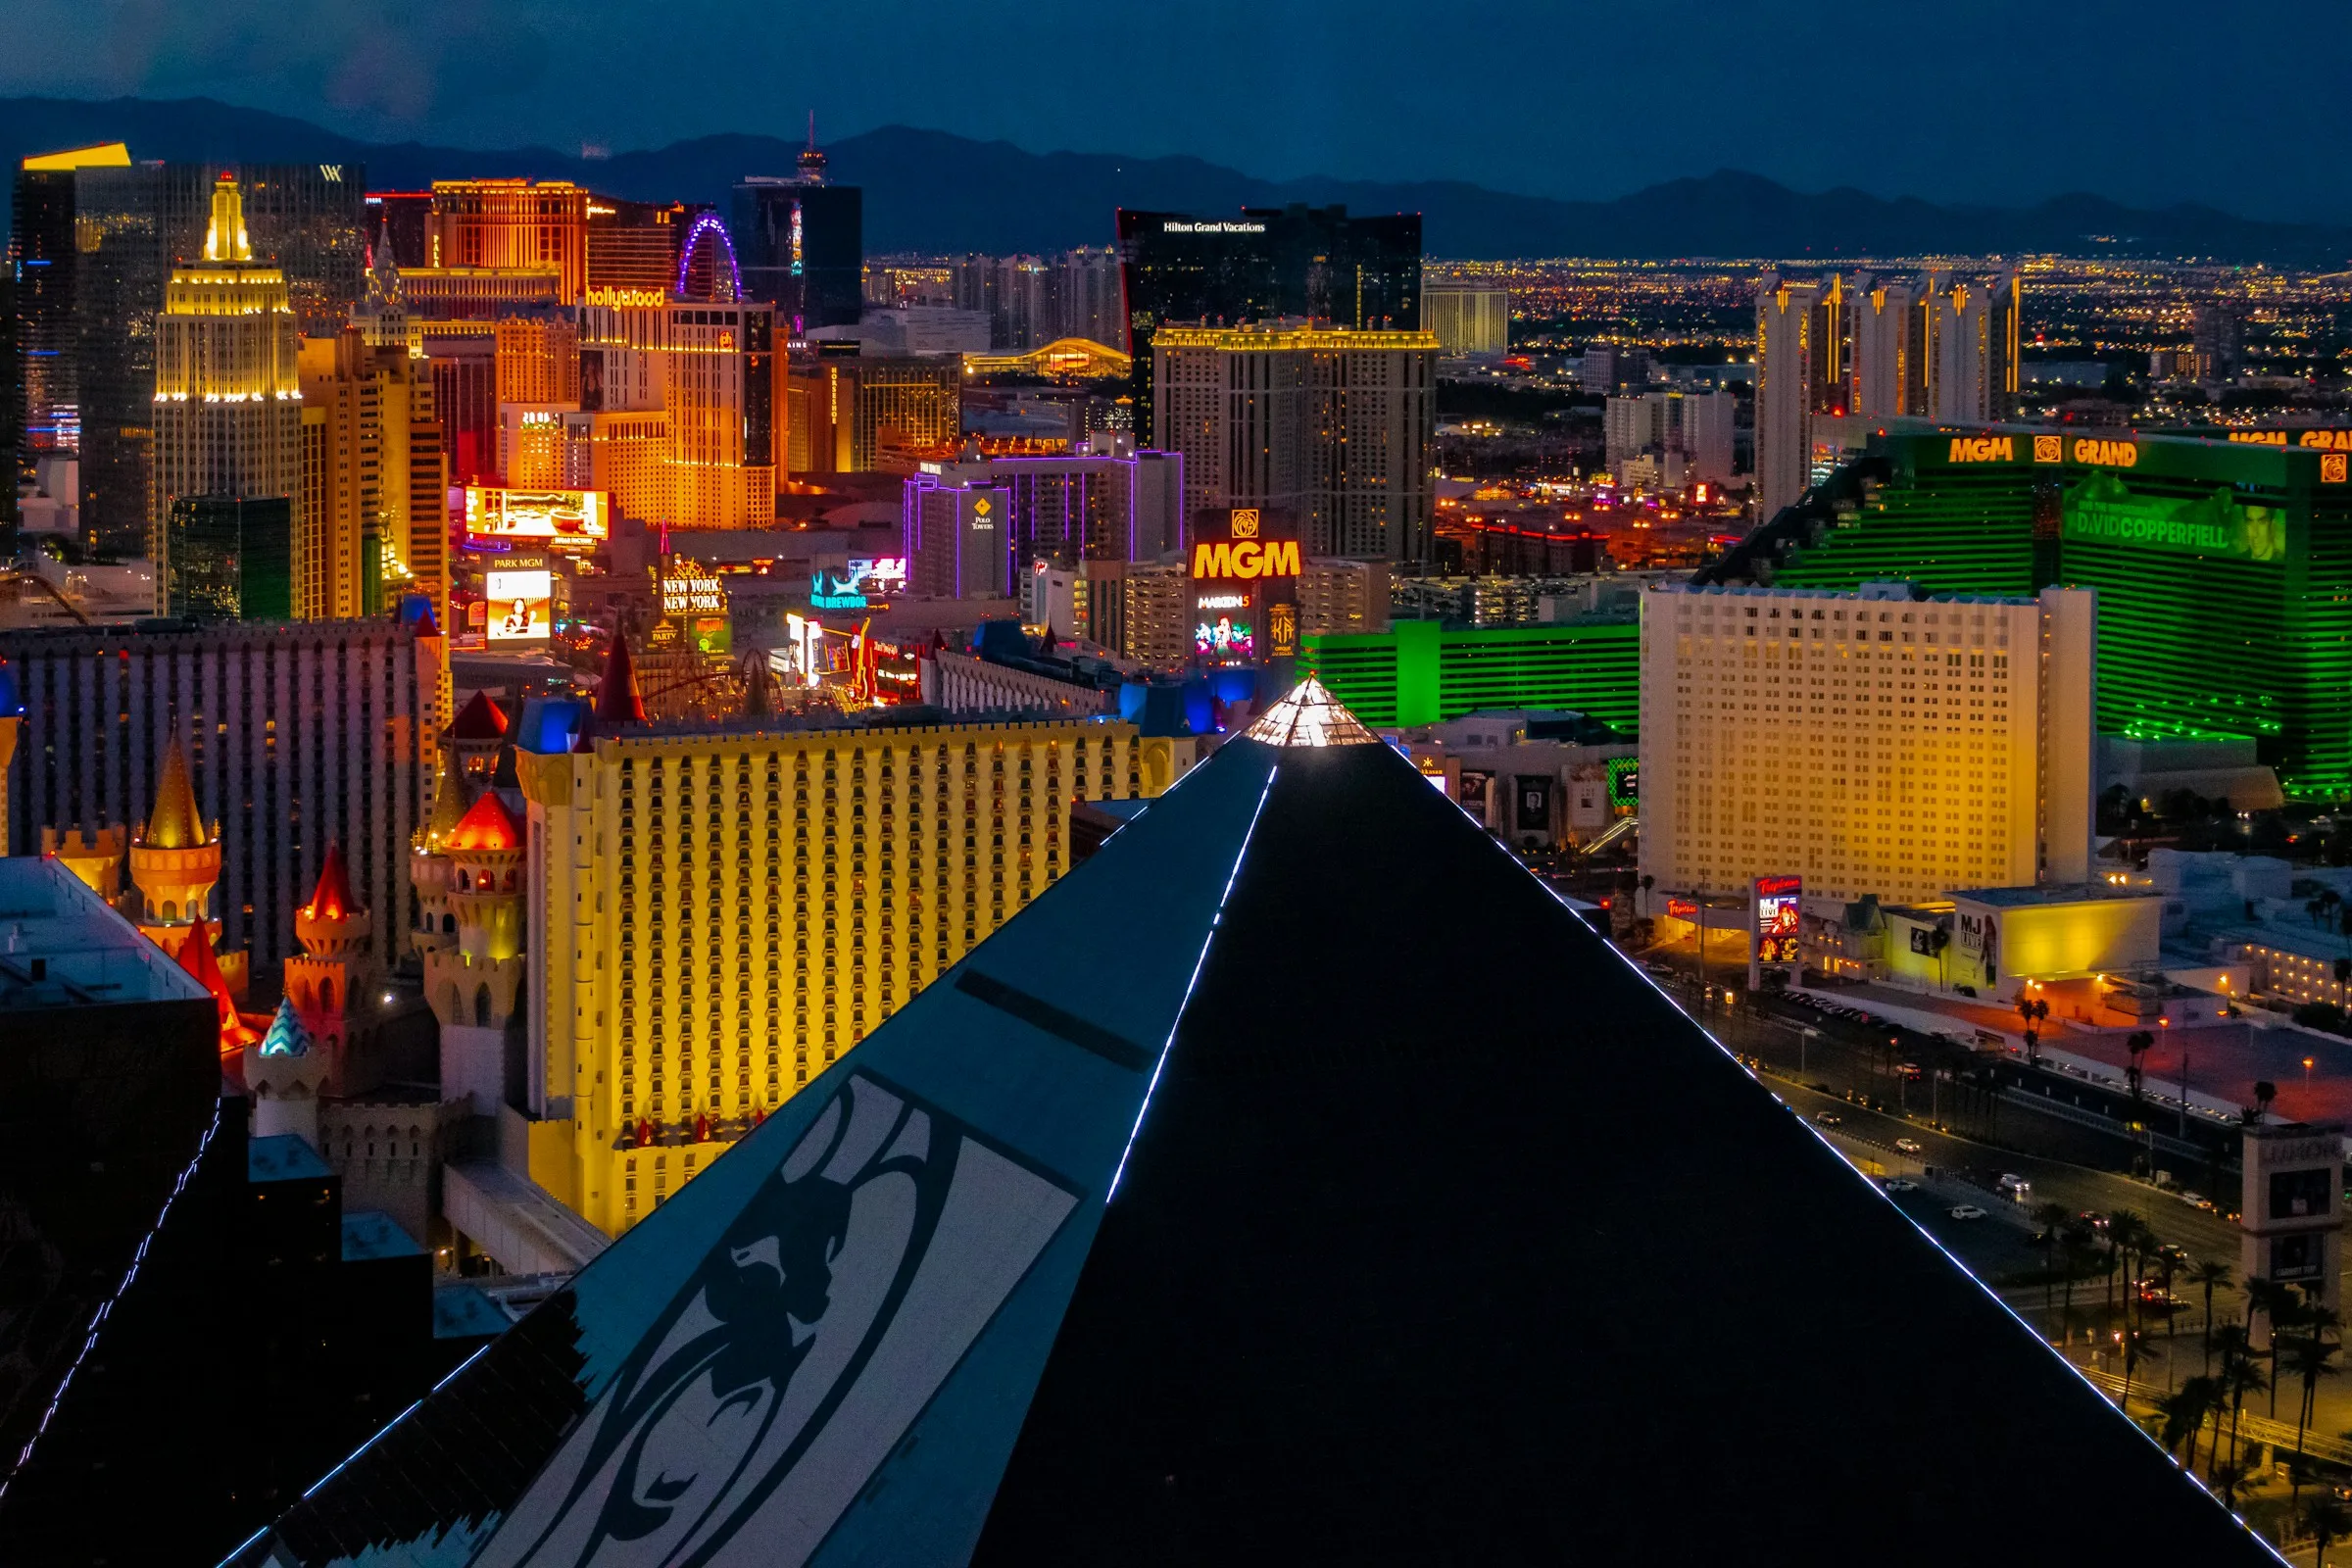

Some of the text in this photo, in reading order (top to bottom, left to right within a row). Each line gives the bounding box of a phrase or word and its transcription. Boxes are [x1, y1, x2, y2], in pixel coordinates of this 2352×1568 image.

[1163, 221, 1265, 232] Hilton Grand Vacations
[585, 285, 664, 312] hollywood
[2299, 430, 2352, 450] GRA
[1948, 437, 2137, 467] MGM GRAND
[494, 558, 543, 568] PARK MGM
[1194, 541, 1301, 579] MGM
[662, 579, 688, 594] NEW
[689, 579, 719, 594] YORK
[662, 595, 720, 610] NEW YORK
[653, 632, 677, 641] PARTY
[1961, 914, 1982, 935] MJ
